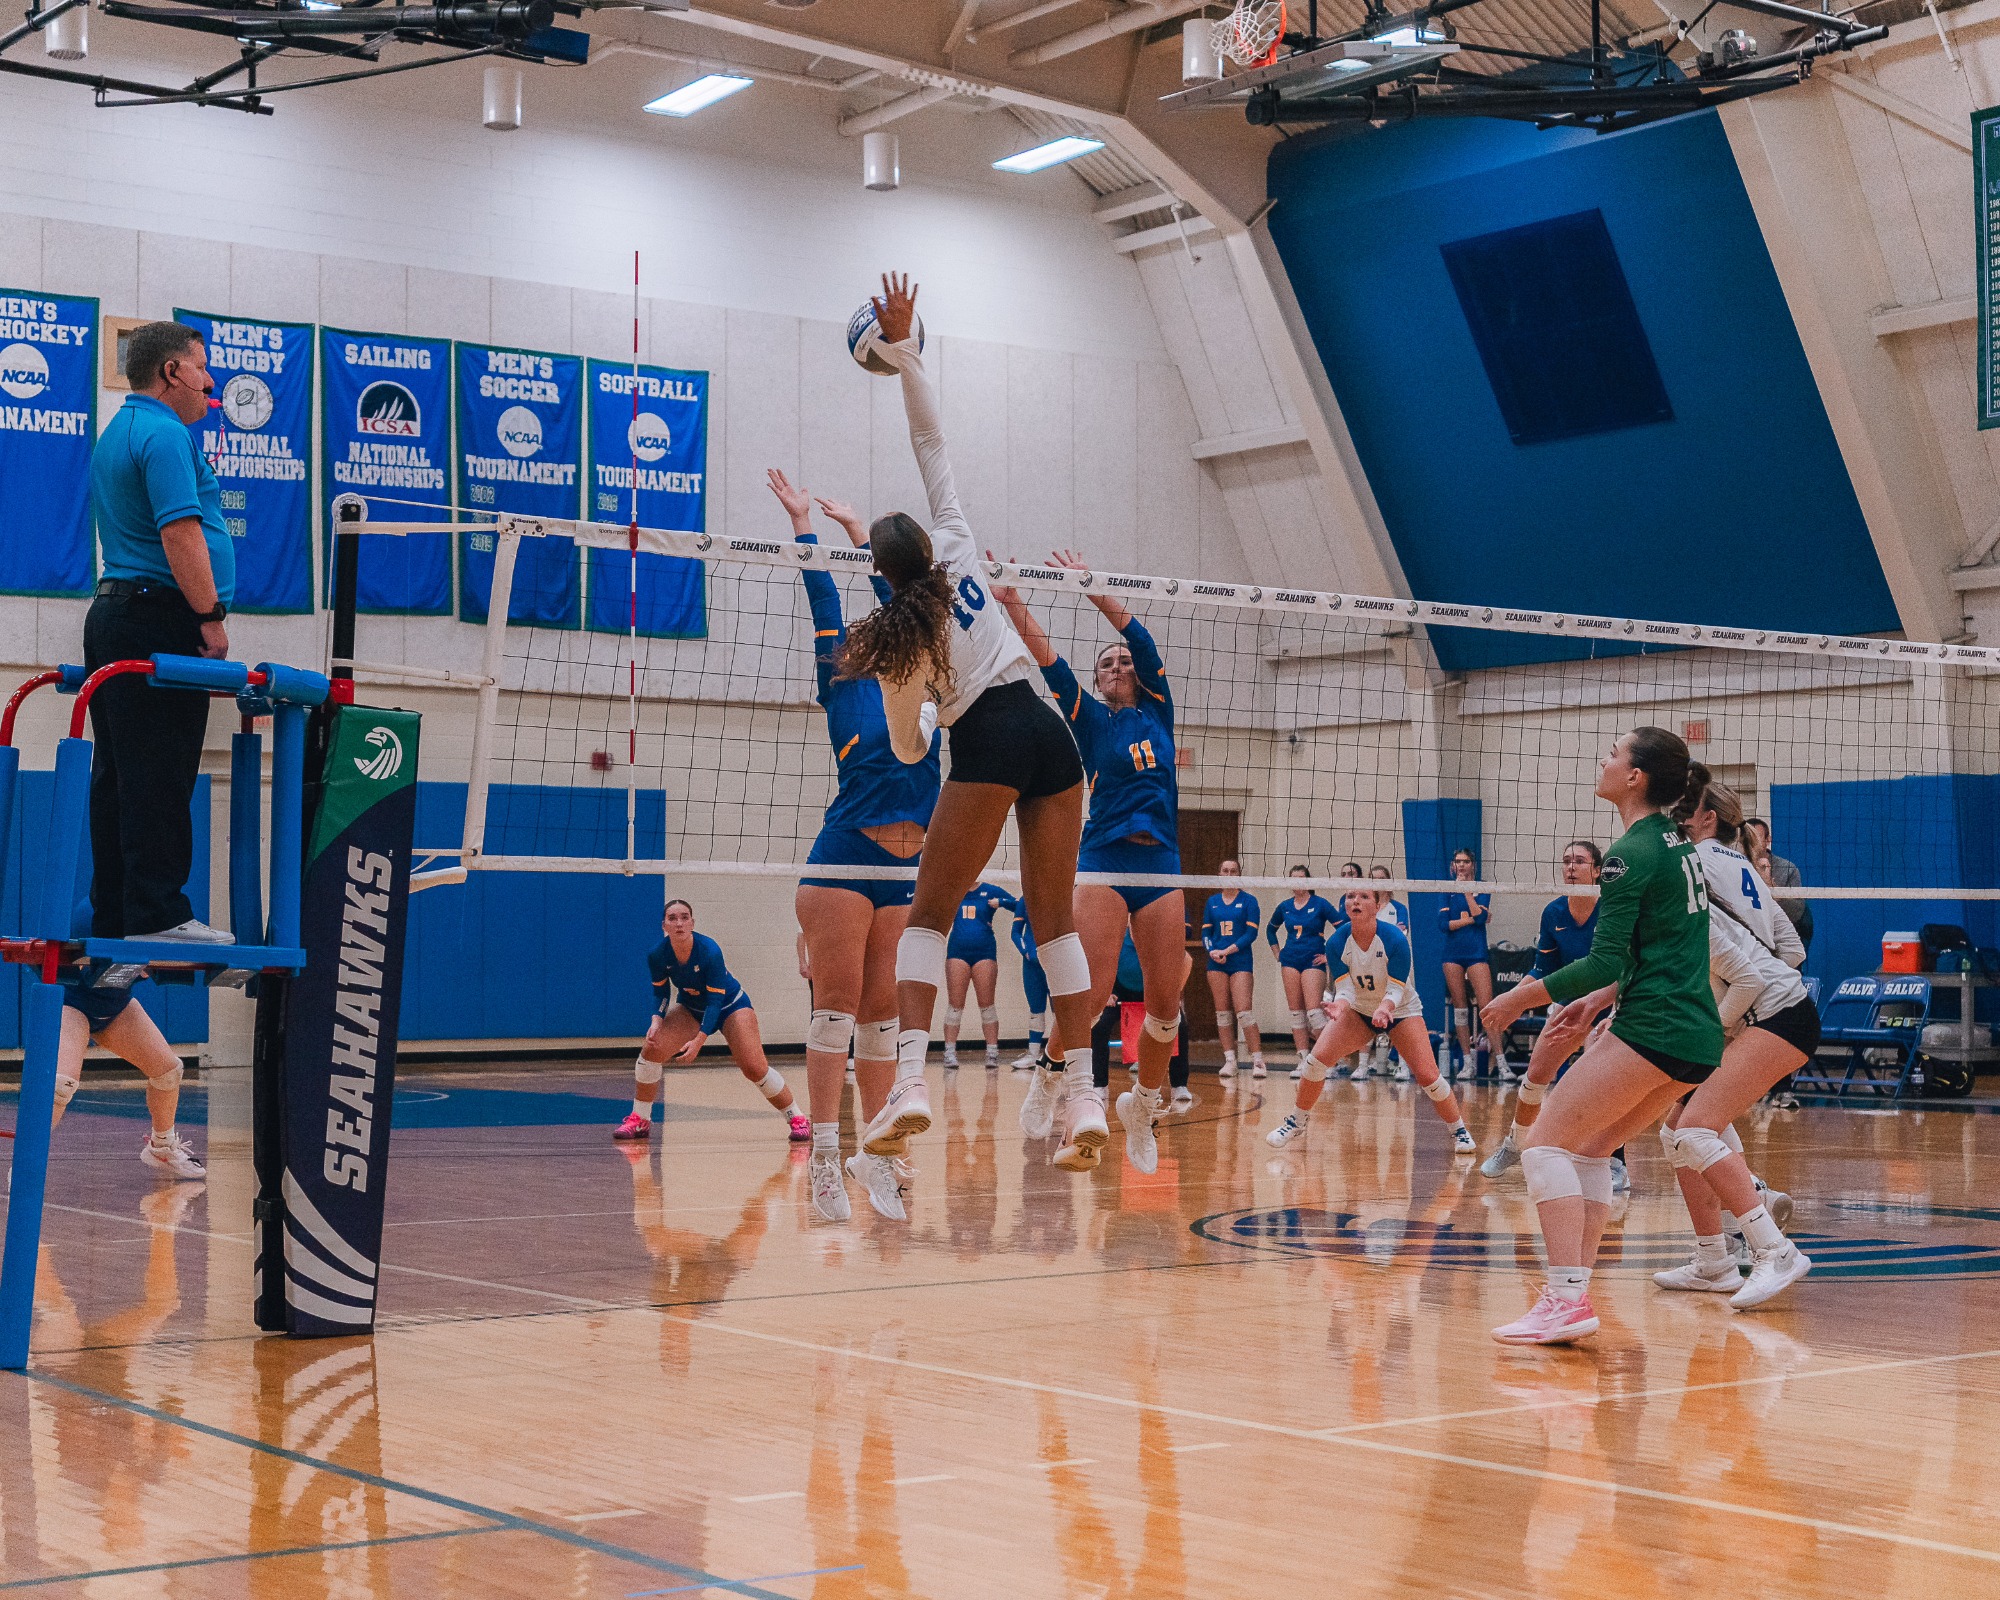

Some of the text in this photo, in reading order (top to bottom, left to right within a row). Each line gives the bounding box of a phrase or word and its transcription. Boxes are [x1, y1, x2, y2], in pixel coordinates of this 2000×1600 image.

[0, 319, 89, 345] HOCKEY
[211, 320, 283, 350] MEN'S
[209, 344, 285, 374] RUGBY
[345, 343, 431, 370] SAILING
[487, 351, 553, 379] MEN'S
[2, 369, 46, 385] NCAA
[480, 375, 560, 404] SOCCER
[599, 372, 698, 402] SOFTBALL
[362, 418, 415, 435] ICSA
[504, 431, 540, 445] NCAA
[203, 430, 292, 458] NATIONAL
[348, 441, 431, 467] NATIONAL
[203, 454, 306, 481] AMPIONSHIPS
[334, 461, 444, 489] CHAMPIONSHIPS
[465, 454, 576, 485] TOURNAMENT
[596, 463, 702, 495] TOURNAMENT
[225, 517, 247, 537] 020
[730, 540, 1987, 658] SEAHAWKS SEAHAWK SEAHAWKS SEAHAWKS SEAHAWKS SEAHAWKS SEAHAWKS SEAHAWKS SEAHAWKS SEAHAWKS SEAHAWKS SEAHAWKS SEAHAWKS SEAHAWKS SEAHAWKS SEAHAWKS
[1129, 739, 1156, 772] 11
[1681, 852, 1708, 915] 15
[1741, 867, 1762, 909] 4
[1220, 921, 1234, 936] 12
[1293, 925, 1303, 940] 7
[1356, 974, 1376, 991] 13
[1839, 983, 1877, 996] SALVE
[1884, 983, 1924, 996] SALVE
[323, 845, 392, 1193] SEAHAWKS
